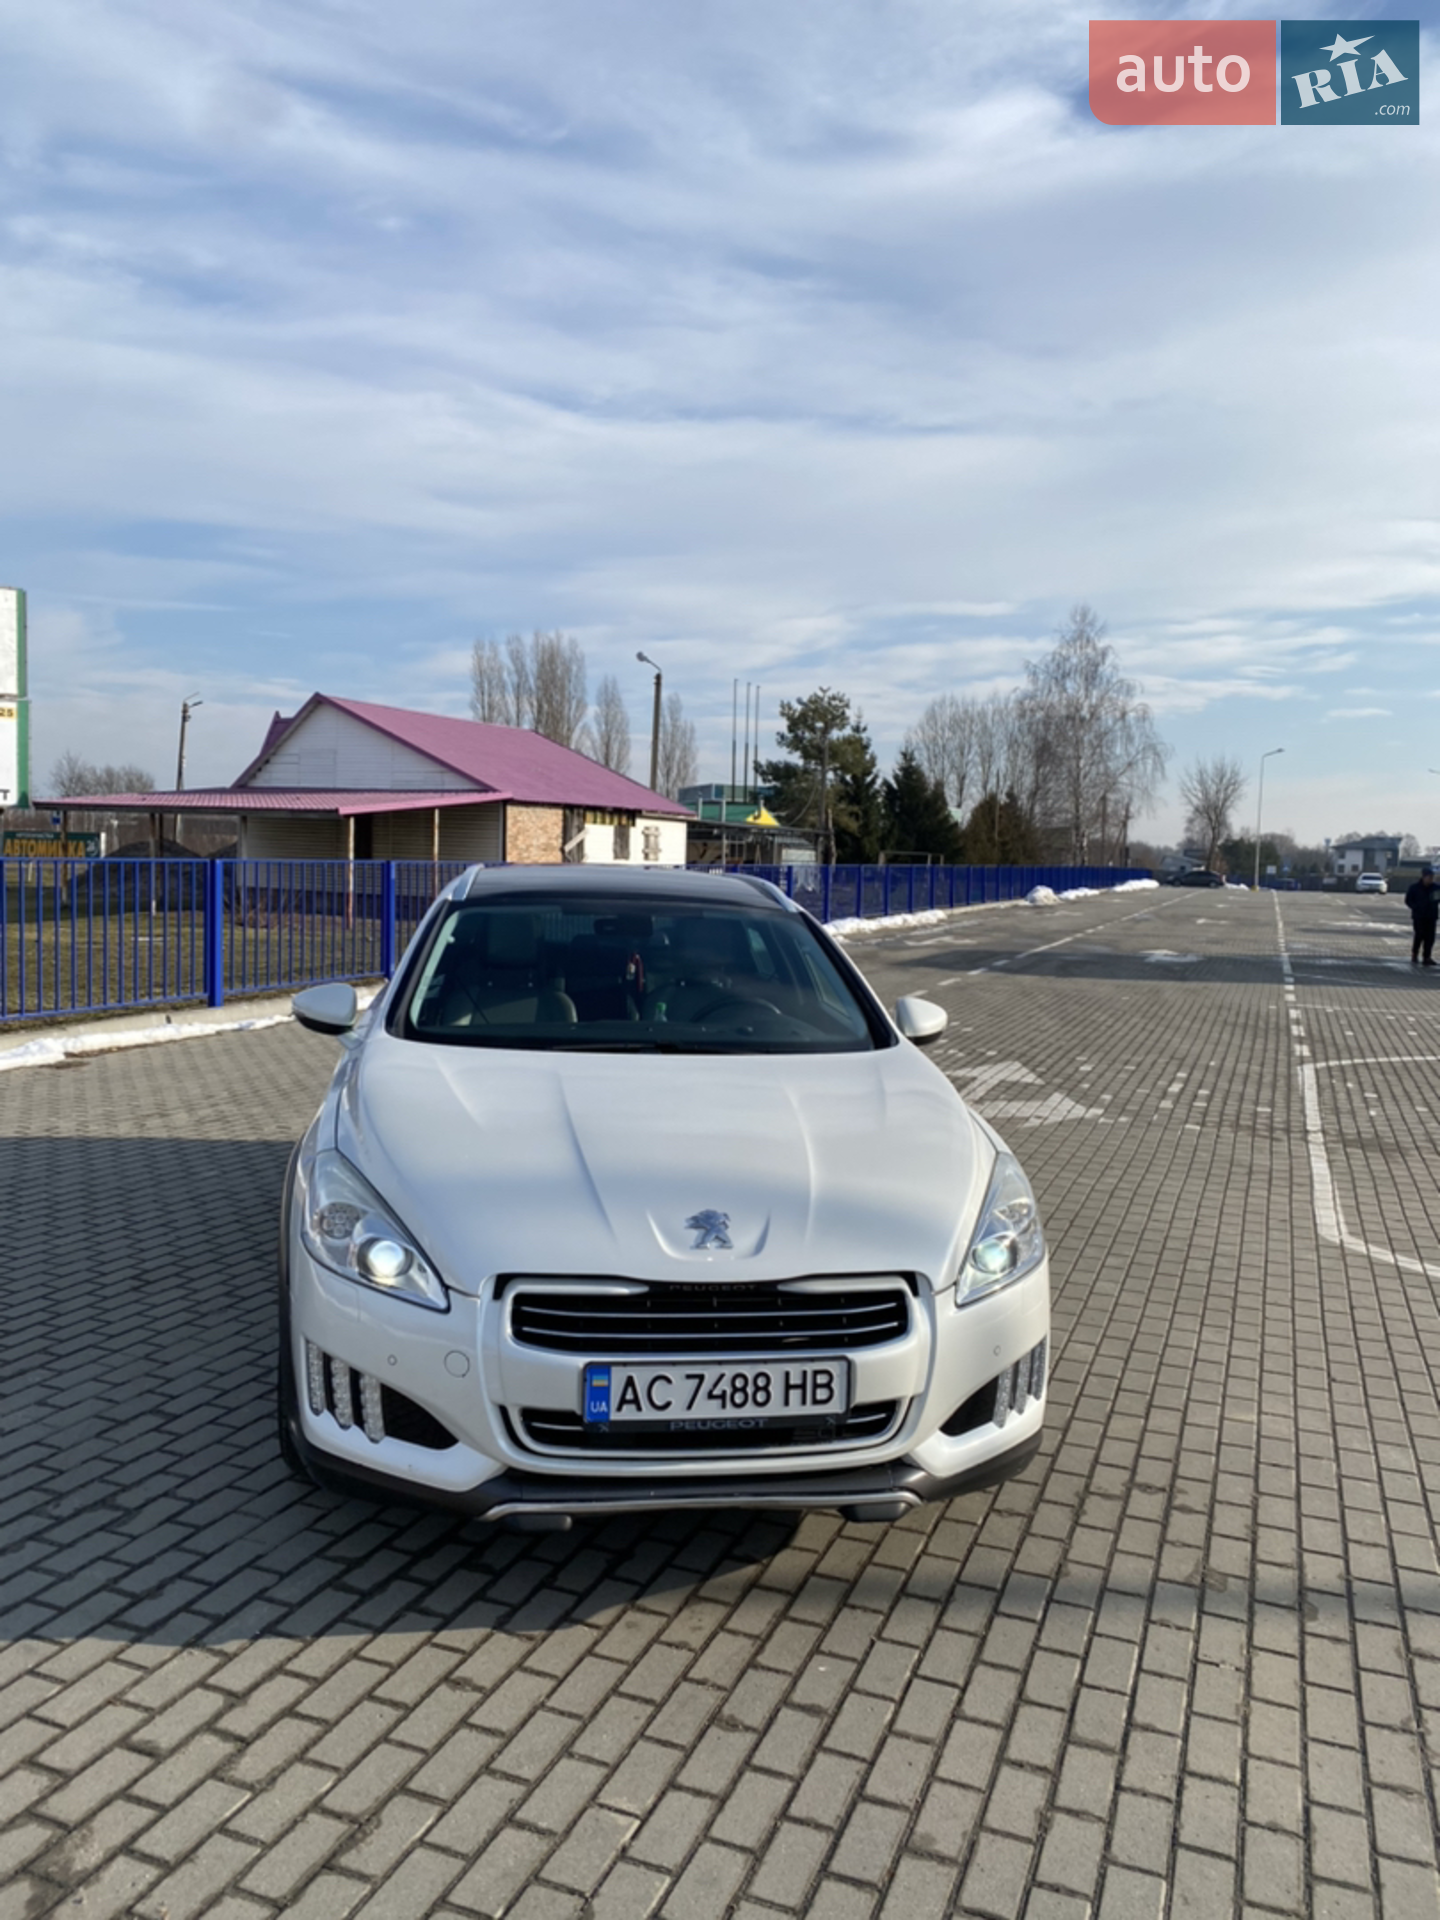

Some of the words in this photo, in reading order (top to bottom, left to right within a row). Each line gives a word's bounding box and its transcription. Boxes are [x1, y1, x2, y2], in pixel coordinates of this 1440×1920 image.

[669, 1284, 757, 1292] PEUGEOT
[590, 1401, 608, 1413] UA
[616, 1374, 673, 1412] AC
[685, 1372, 772, 1411] 7488
[783, 1369, 835, 1407] HB
[670, 1418, 768, 1431] PEUGEOT
